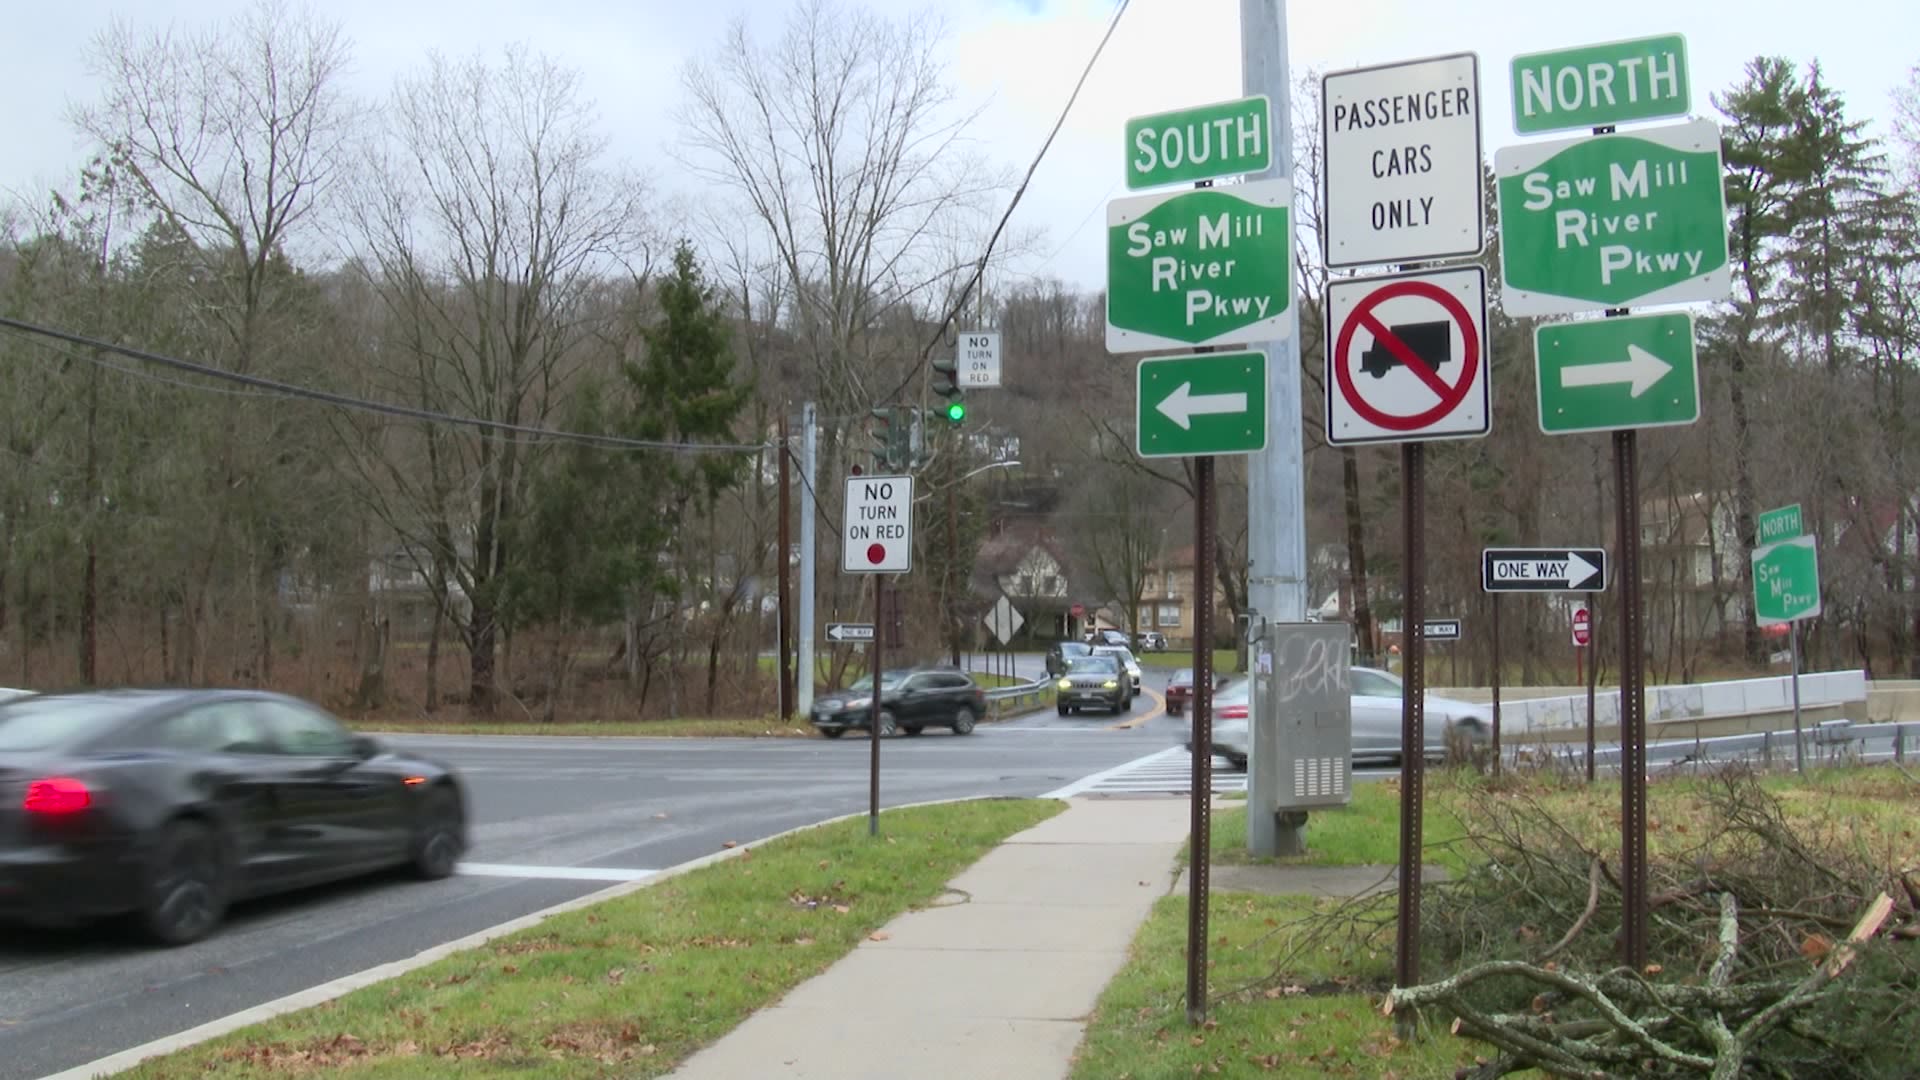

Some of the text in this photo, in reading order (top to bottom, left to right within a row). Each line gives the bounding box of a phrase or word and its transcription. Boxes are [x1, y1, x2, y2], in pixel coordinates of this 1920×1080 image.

[1521, 53, 1679, 116] NORTH
[1334, 87, 1470, 132] PASSENGER
[1134, 113, 1262, 173] SOUTH
[1372, 144, 1432, 178] CARS
[1522, 159, 1688, 211] Saw Mill
[1371, 196, 1434, 230] ONLY
[1555, 208, 1658, 249] River
[1127, 212, 1263, 257] Saw Mill
[1152, 256, 1236, 292] River
[1600, 244, 1704, 286] Pkwy
[1186, 289, 1271, 326] Pkwy
[967, 350, 992, 359] TURN
[969, 336, 989, 348] NO
[970, 373, 989, 383] RED
[972, 361, 987, 371] ON
[865, 483, 893, 501] NO
[859, 505, 897, 520] TURN
[1763, 512, 1799, 538] NORTH
[850, 524, 905, 540] ON RED
[1498, 562, 1568, 578] ONE WAY
